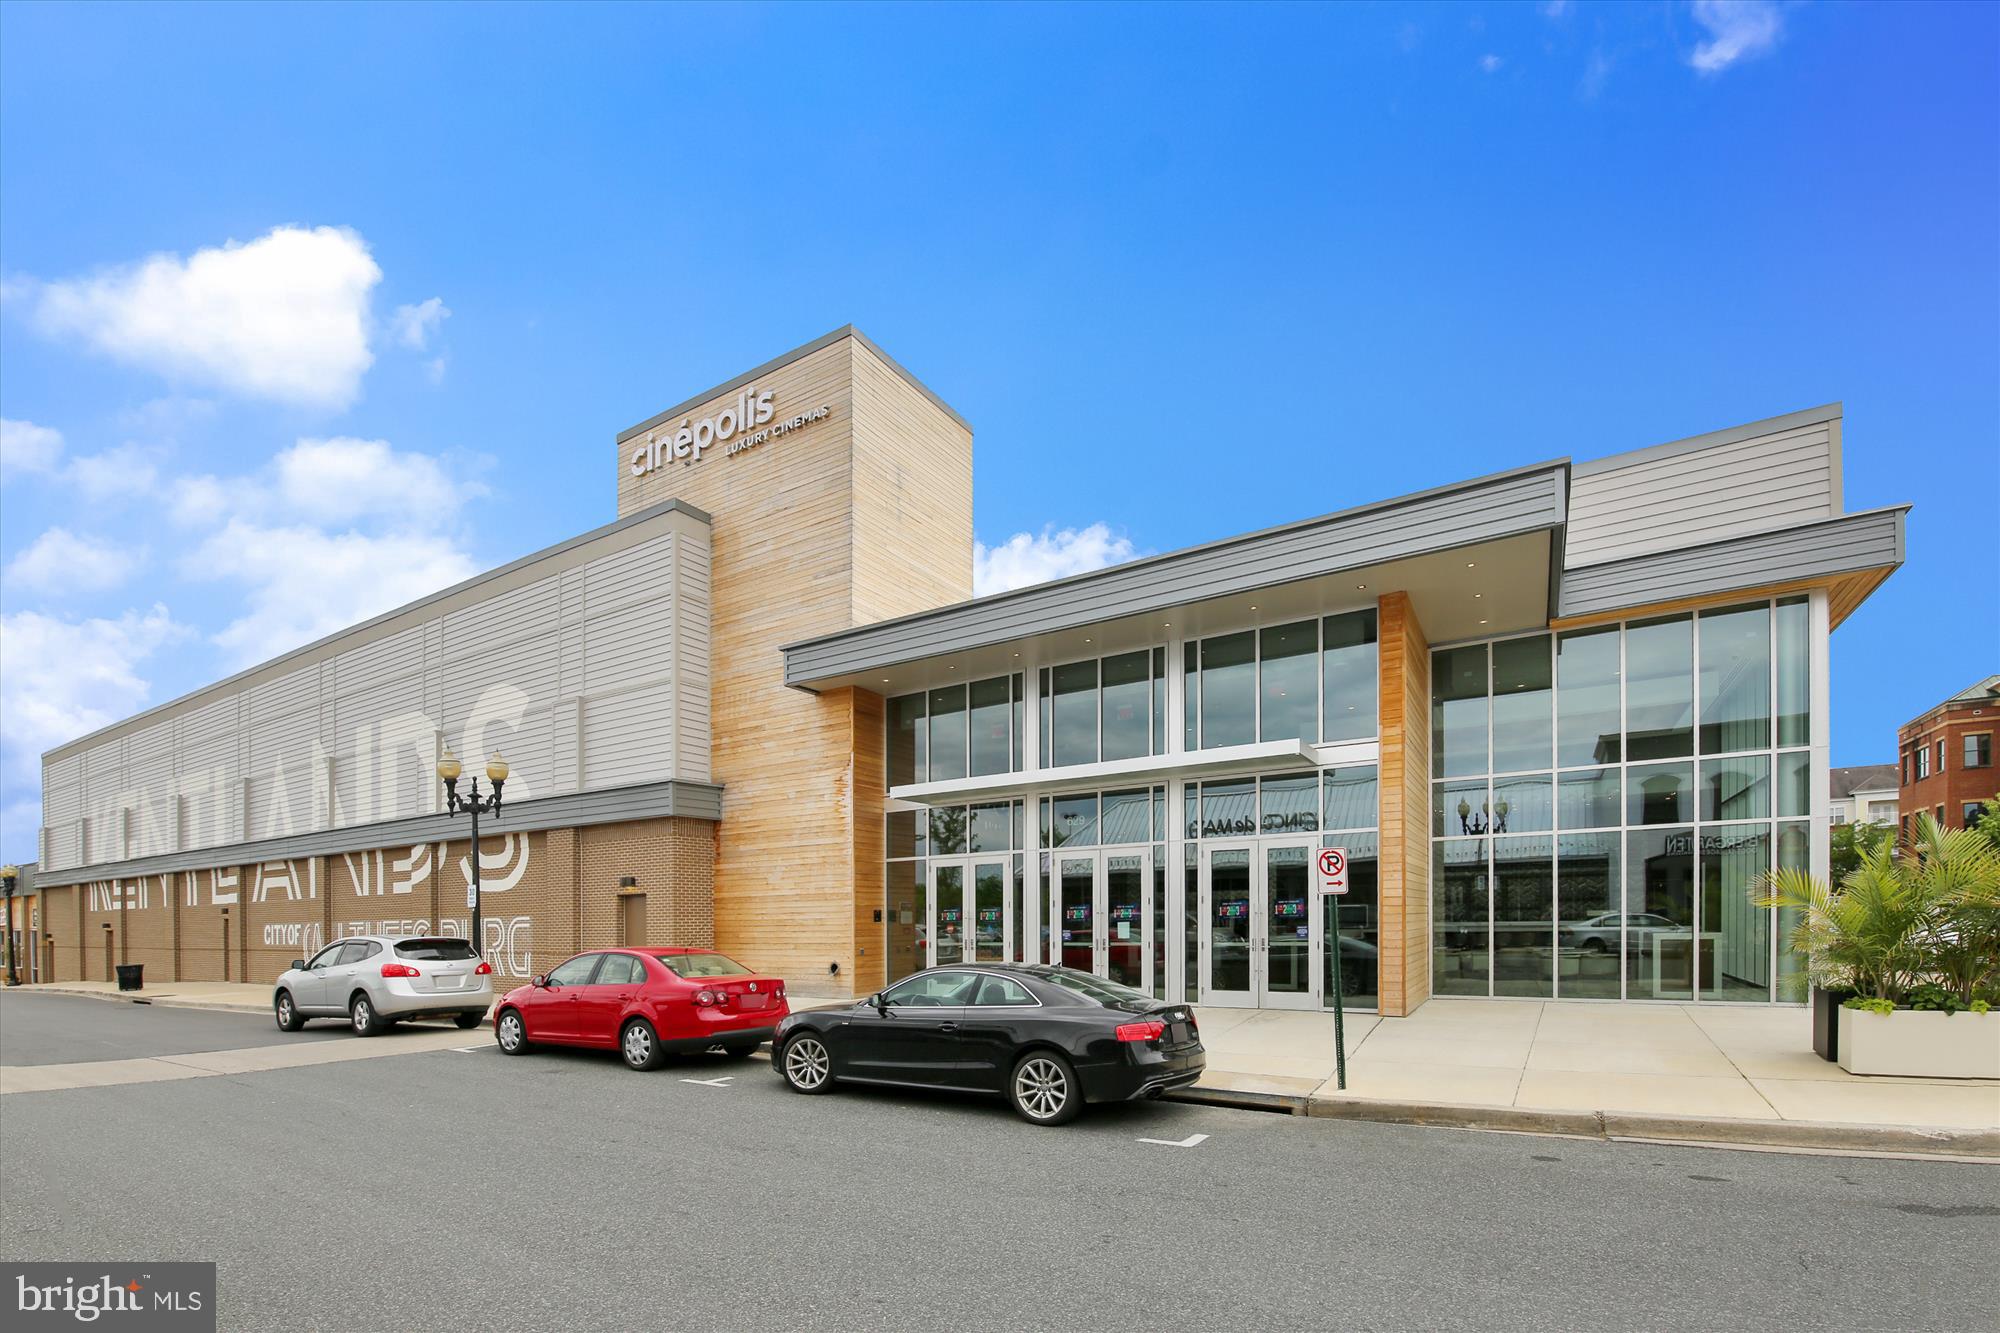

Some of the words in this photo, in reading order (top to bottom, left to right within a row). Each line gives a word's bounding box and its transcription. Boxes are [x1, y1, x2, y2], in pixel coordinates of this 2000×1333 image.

[631, 386, 776, 477] cinépolis
[725, 428, 770, 457] LUXURY
[772, 403, 832, 437] CINEMAS
[264, 924, 287, 945] CITY
[288, 924, 301, 945] OF
